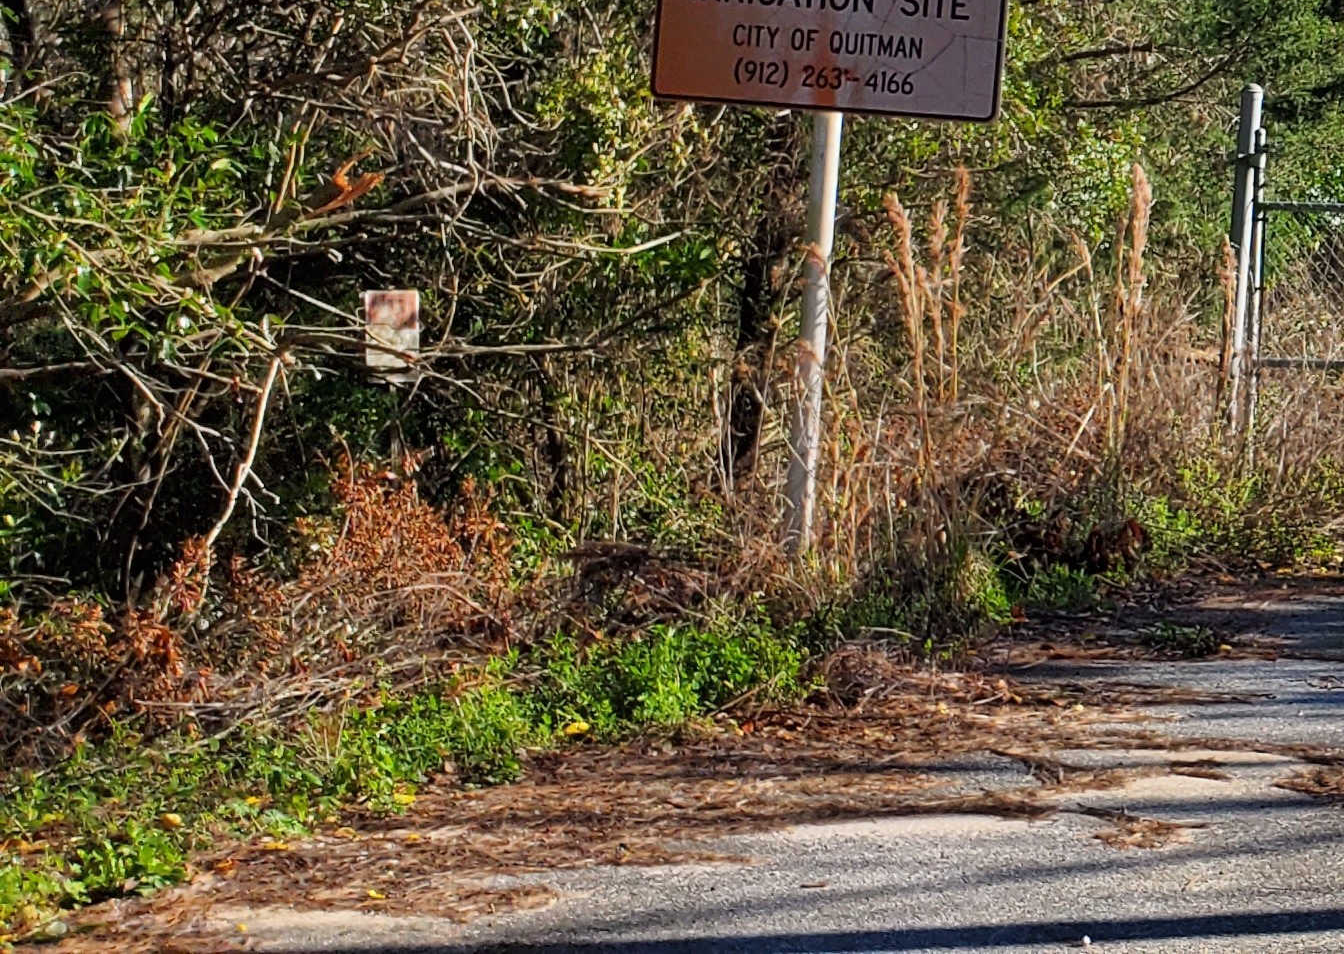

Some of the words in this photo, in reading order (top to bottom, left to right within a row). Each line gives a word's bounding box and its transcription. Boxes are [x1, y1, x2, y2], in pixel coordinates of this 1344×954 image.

[733, 24, 780, 47] CITY
[791, 28, 819, 51] OF
[830, 31, 923, 59] QUITMAN
[734, 58, 789, 88] (912)
